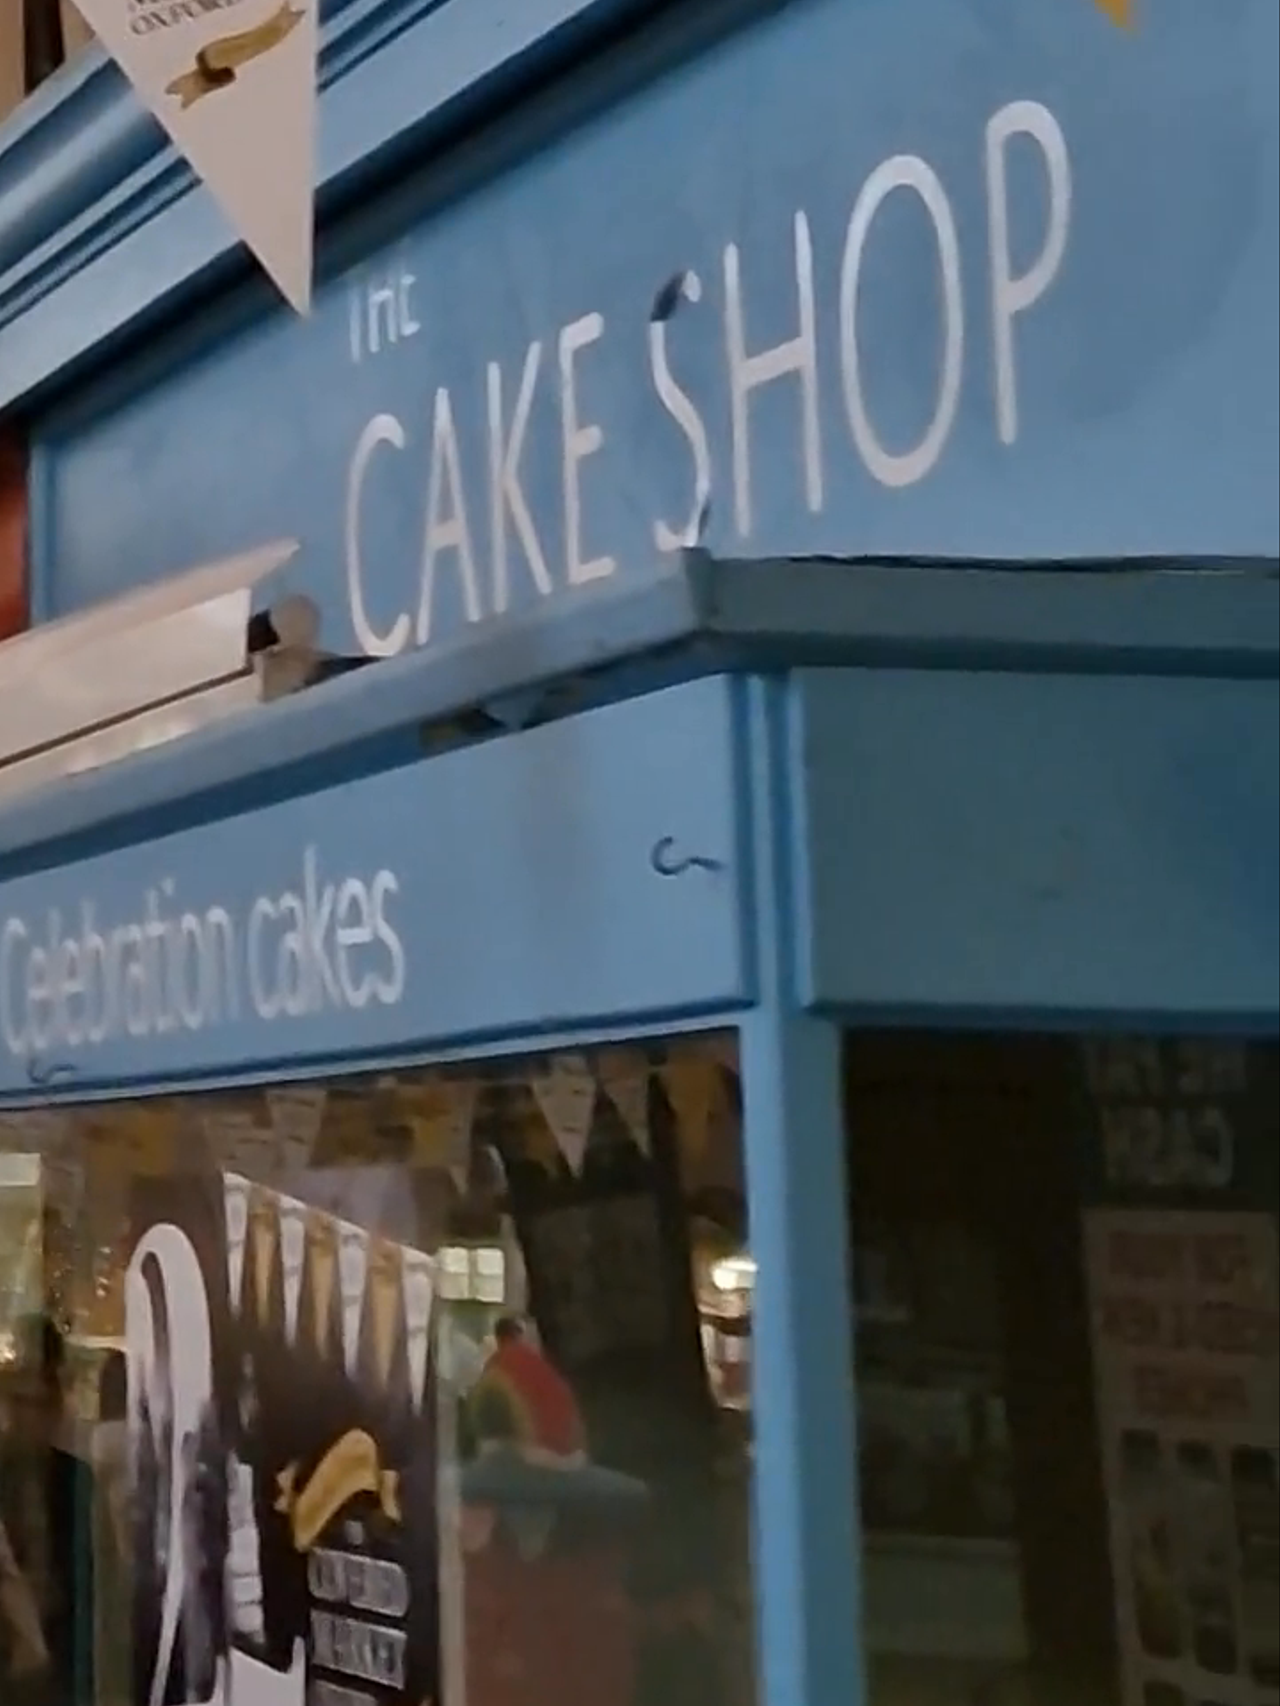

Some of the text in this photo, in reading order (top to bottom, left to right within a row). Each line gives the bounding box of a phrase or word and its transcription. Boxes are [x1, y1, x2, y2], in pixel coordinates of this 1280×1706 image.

[344, 98, 1073, 659] CAKE SHOP
[247, 844, 406, 1020] cakes
